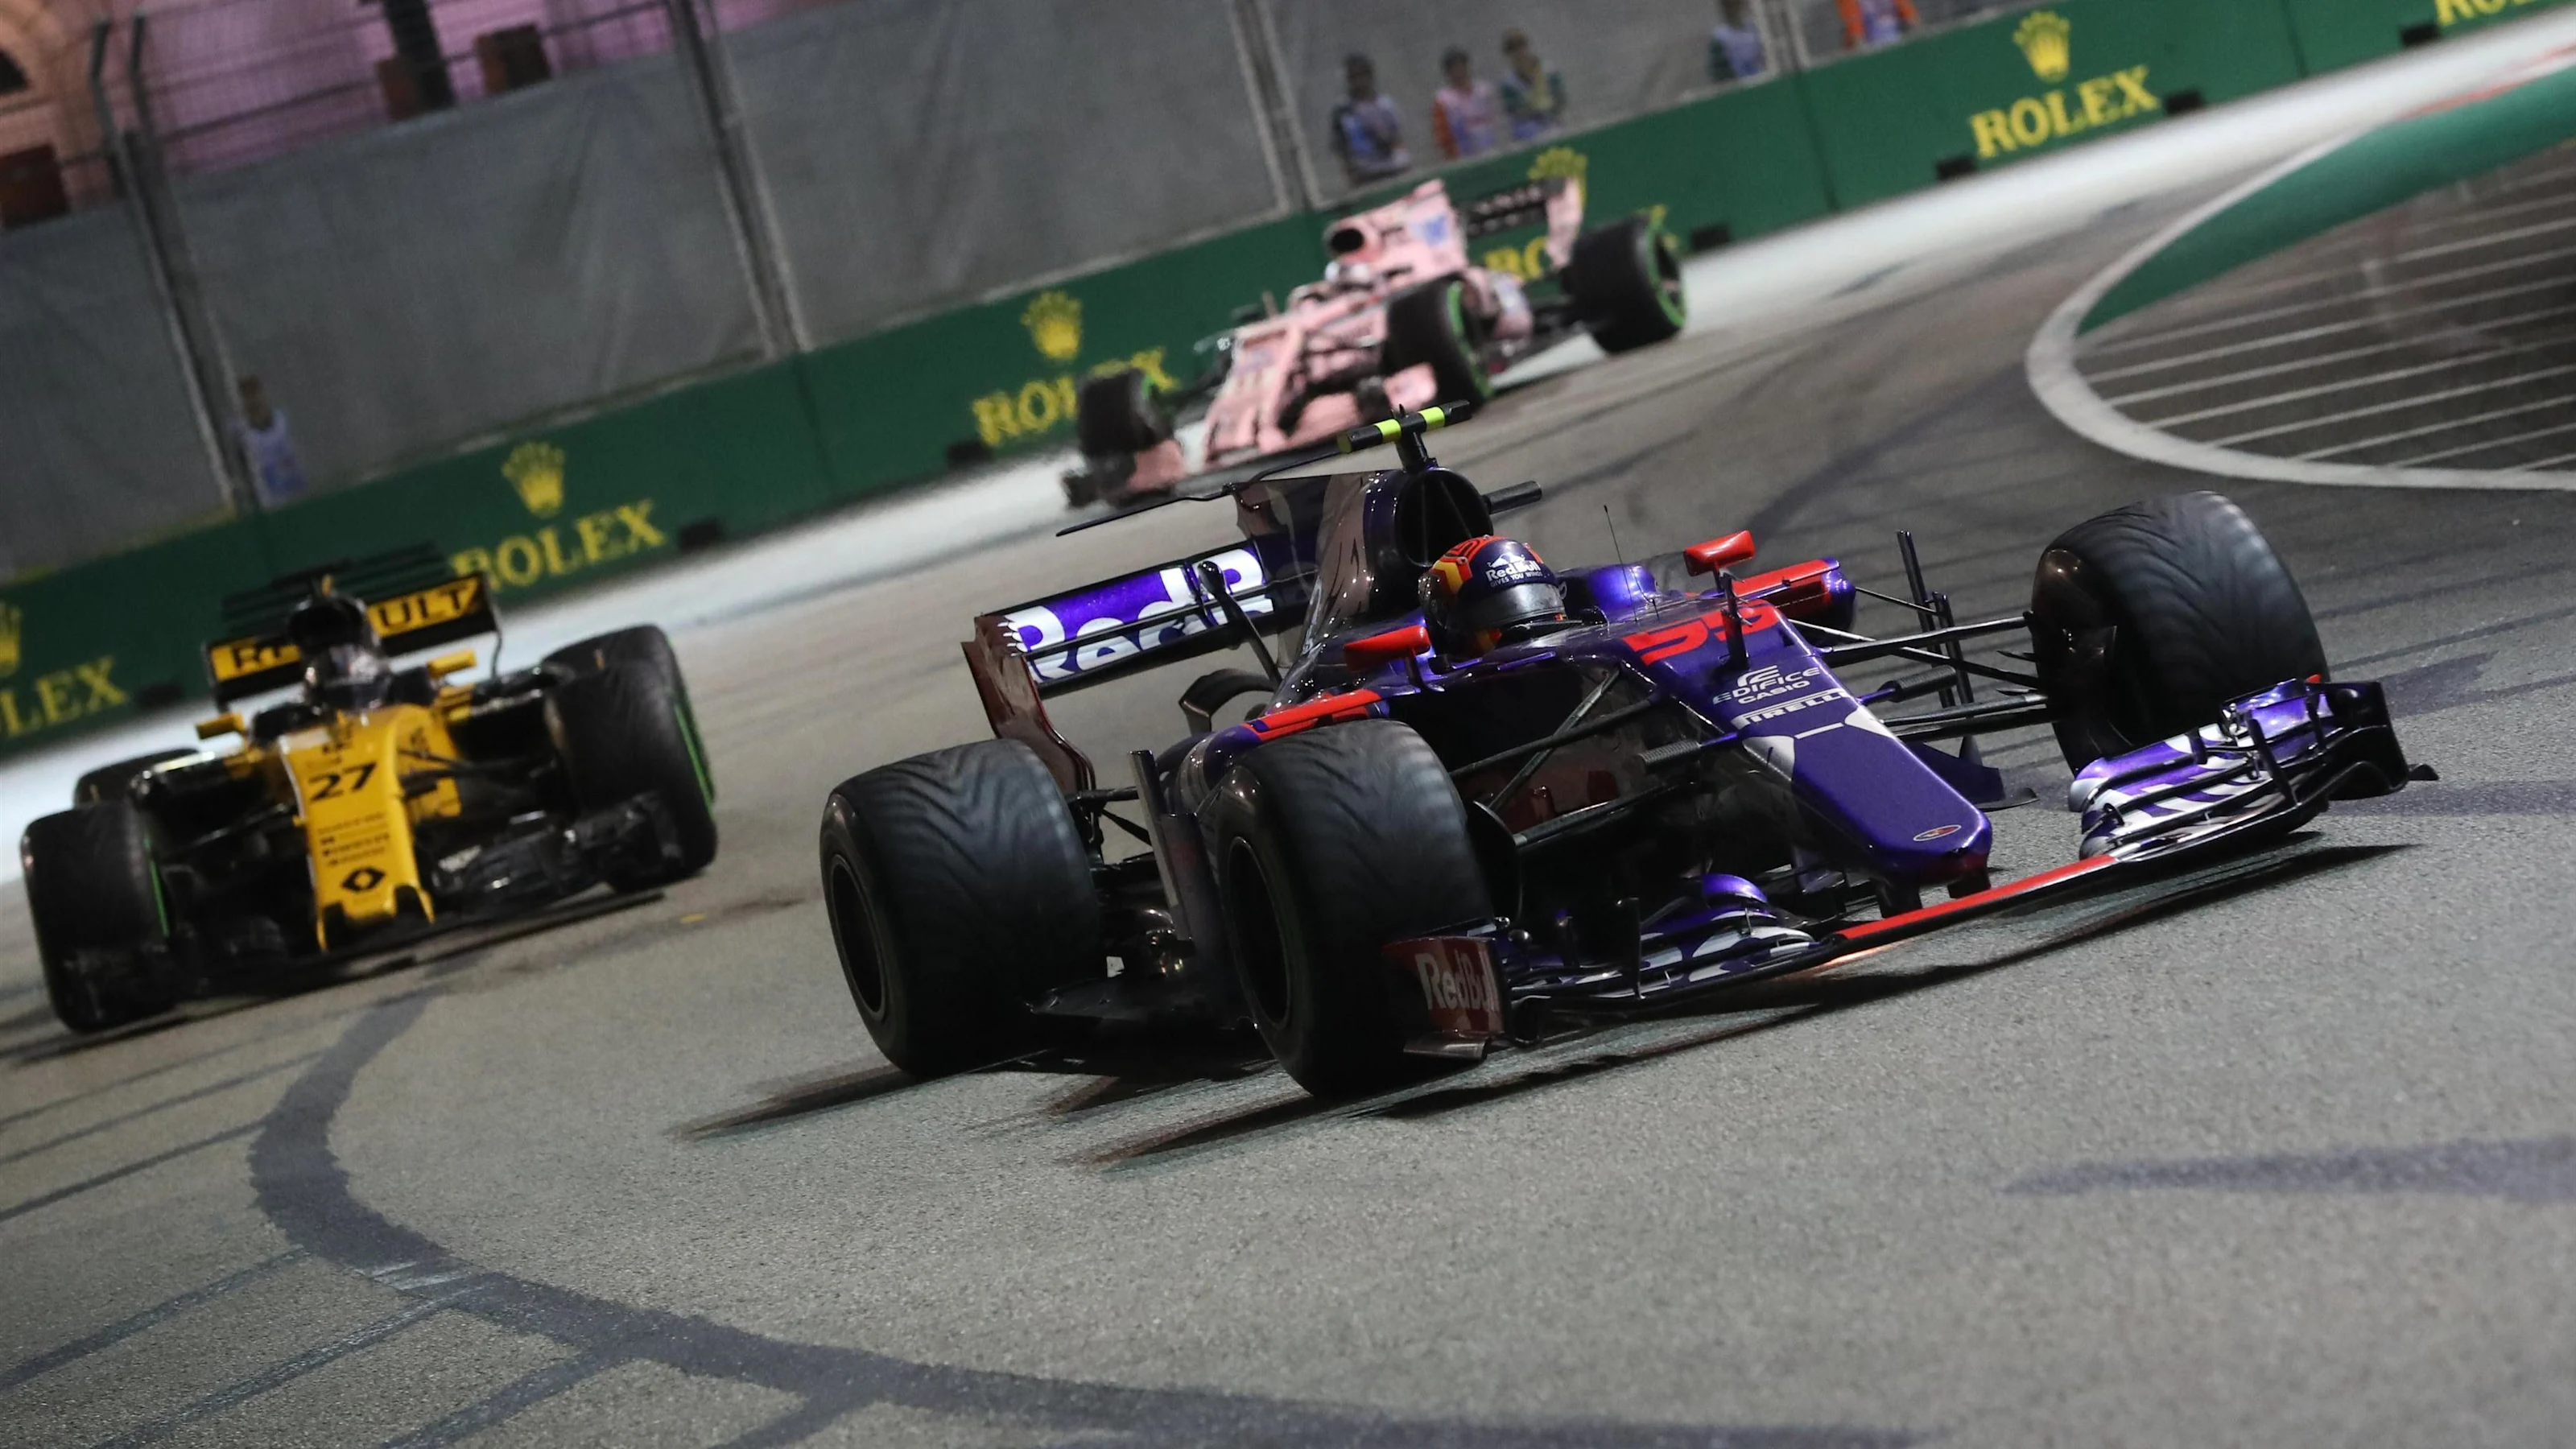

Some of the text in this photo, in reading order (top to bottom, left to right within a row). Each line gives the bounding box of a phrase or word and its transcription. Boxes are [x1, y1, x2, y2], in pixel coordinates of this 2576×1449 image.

[1971, 65, 2161, 157] ROLEX
[973, 346, 1178, 446] ROLX
[1510, 572, 1524, 580] YOU
[1712, 667, 1821, 705] EDIFICE
[1738, 680, 1810, 704] CASIO
[308, 761, 378, 802] 27
